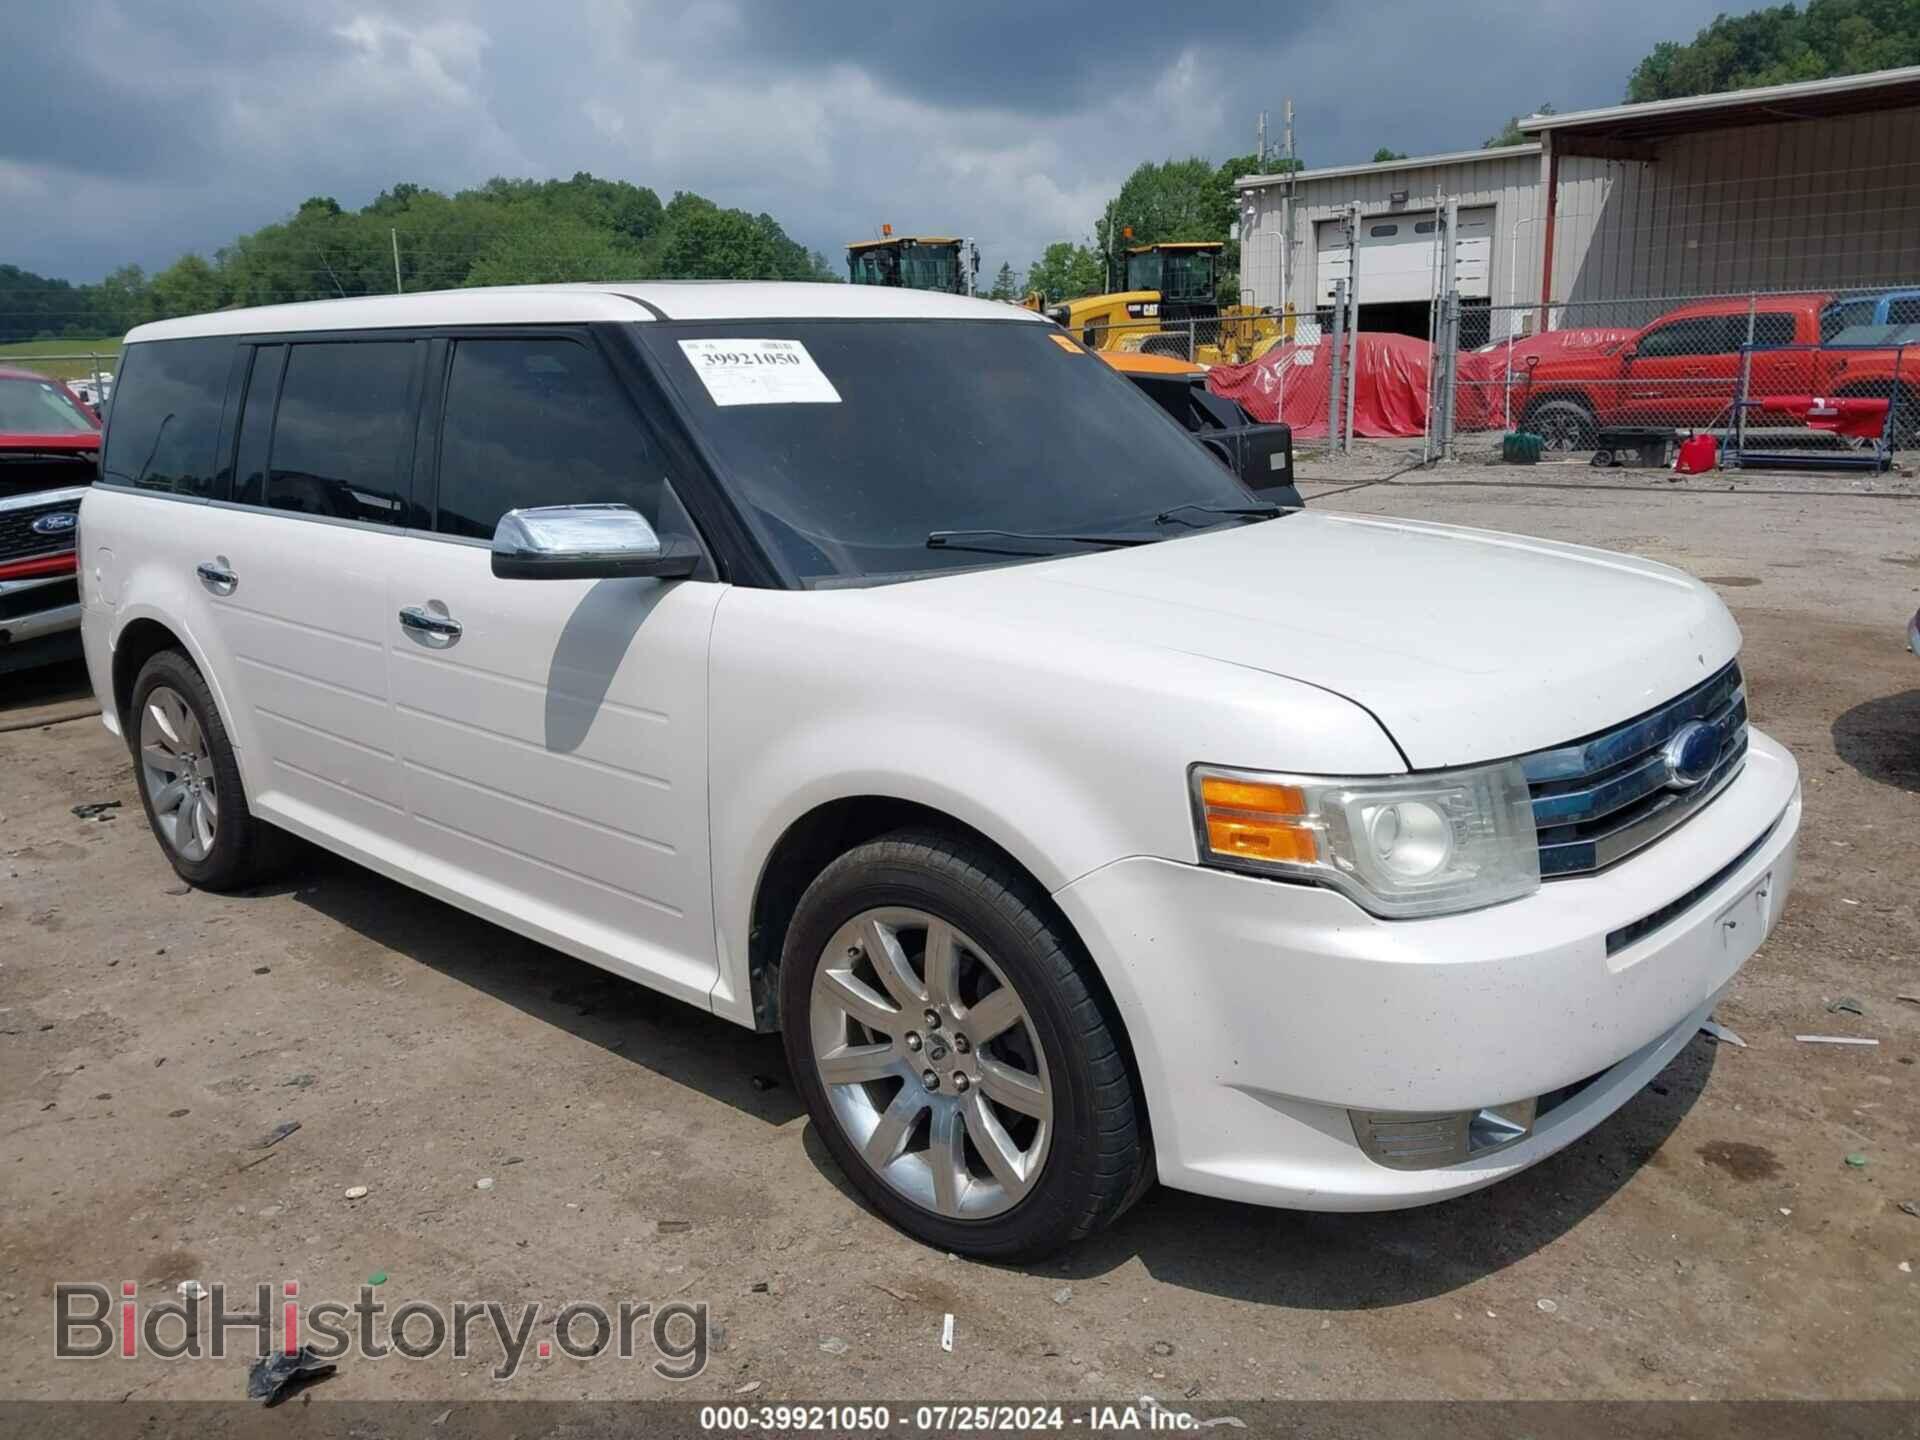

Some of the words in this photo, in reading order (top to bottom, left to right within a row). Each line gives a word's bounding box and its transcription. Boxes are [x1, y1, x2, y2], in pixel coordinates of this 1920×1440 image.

[1143, 304, 1158, 316] CAT
[702, 352, 800, 366] 39921050
[46, 516, 74, 529] Ford
